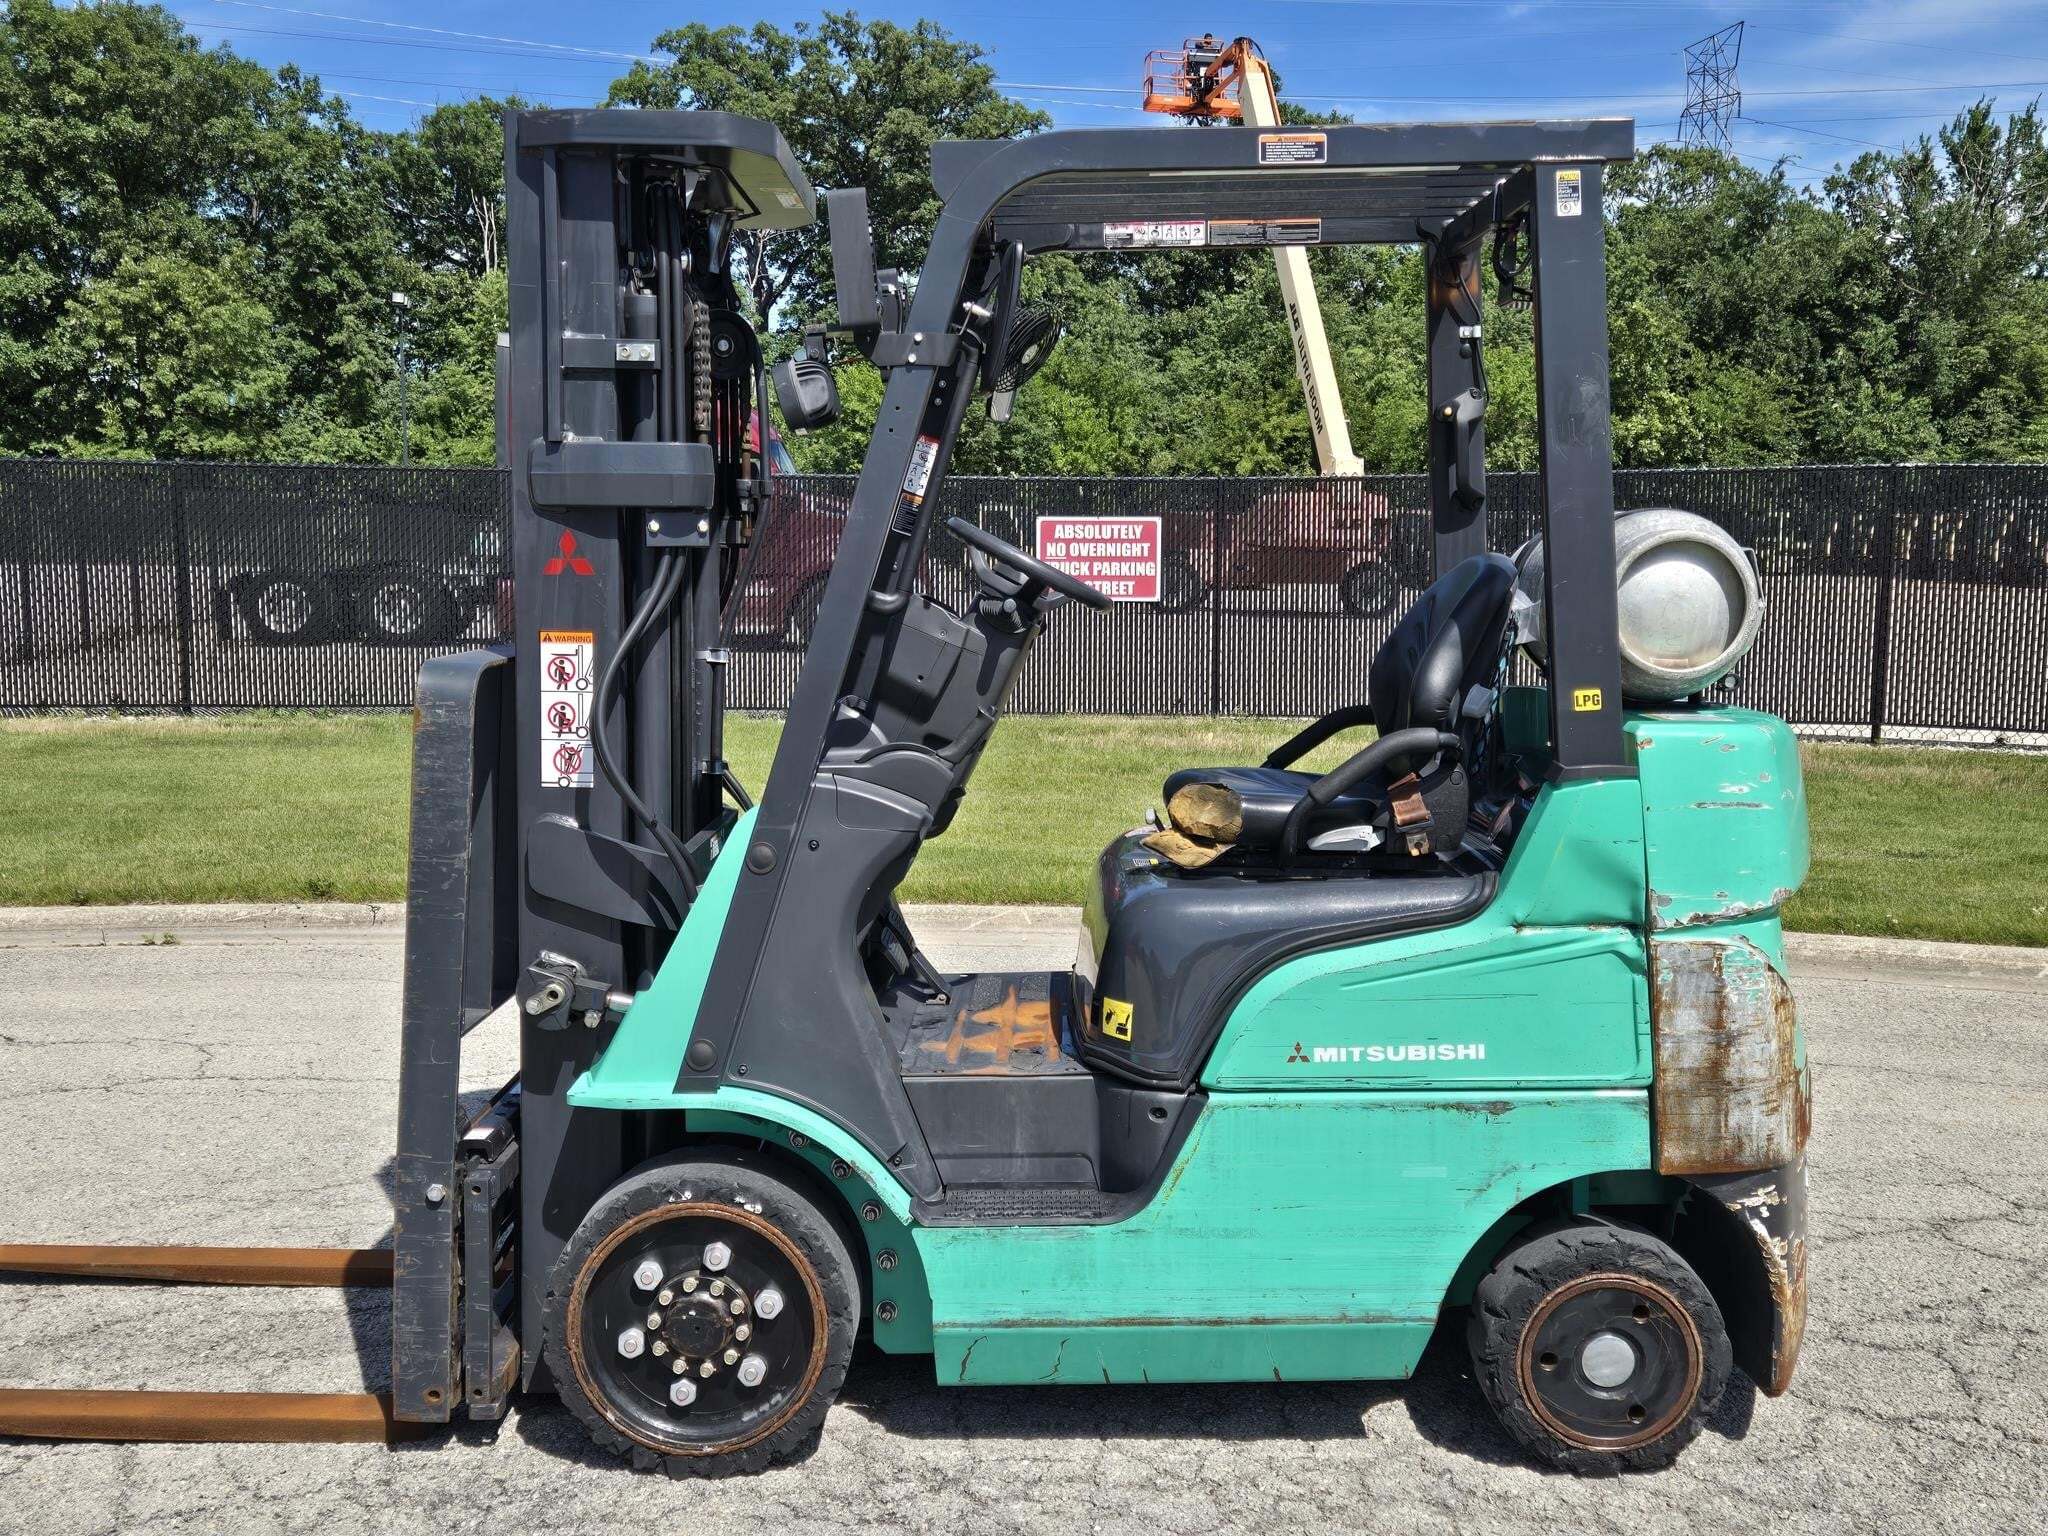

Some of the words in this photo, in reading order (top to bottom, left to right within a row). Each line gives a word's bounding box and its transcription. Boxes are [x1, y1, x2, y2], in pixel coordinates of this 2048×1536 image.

[1289, 302, 1300, 332] JLG
[1297, 334, 1312, 386] ULTRA
[1308, 385, 1323, 434] BOOM
[1054, 524, 1143, 539] ABSOLUTELY
[1046, 542, 1066, 557] NO
[1069, 542, 1151, 557] OVERNIGHT
[1045, 561, 1090, 576] RUCK
[1093, 561, 1156, 576] PARKING
[554, 635, 592, 644] WARNING
[1575, 694, 1601, 707] LPG
[1313, 1044, 1486, 1063] MITSUBISHI
